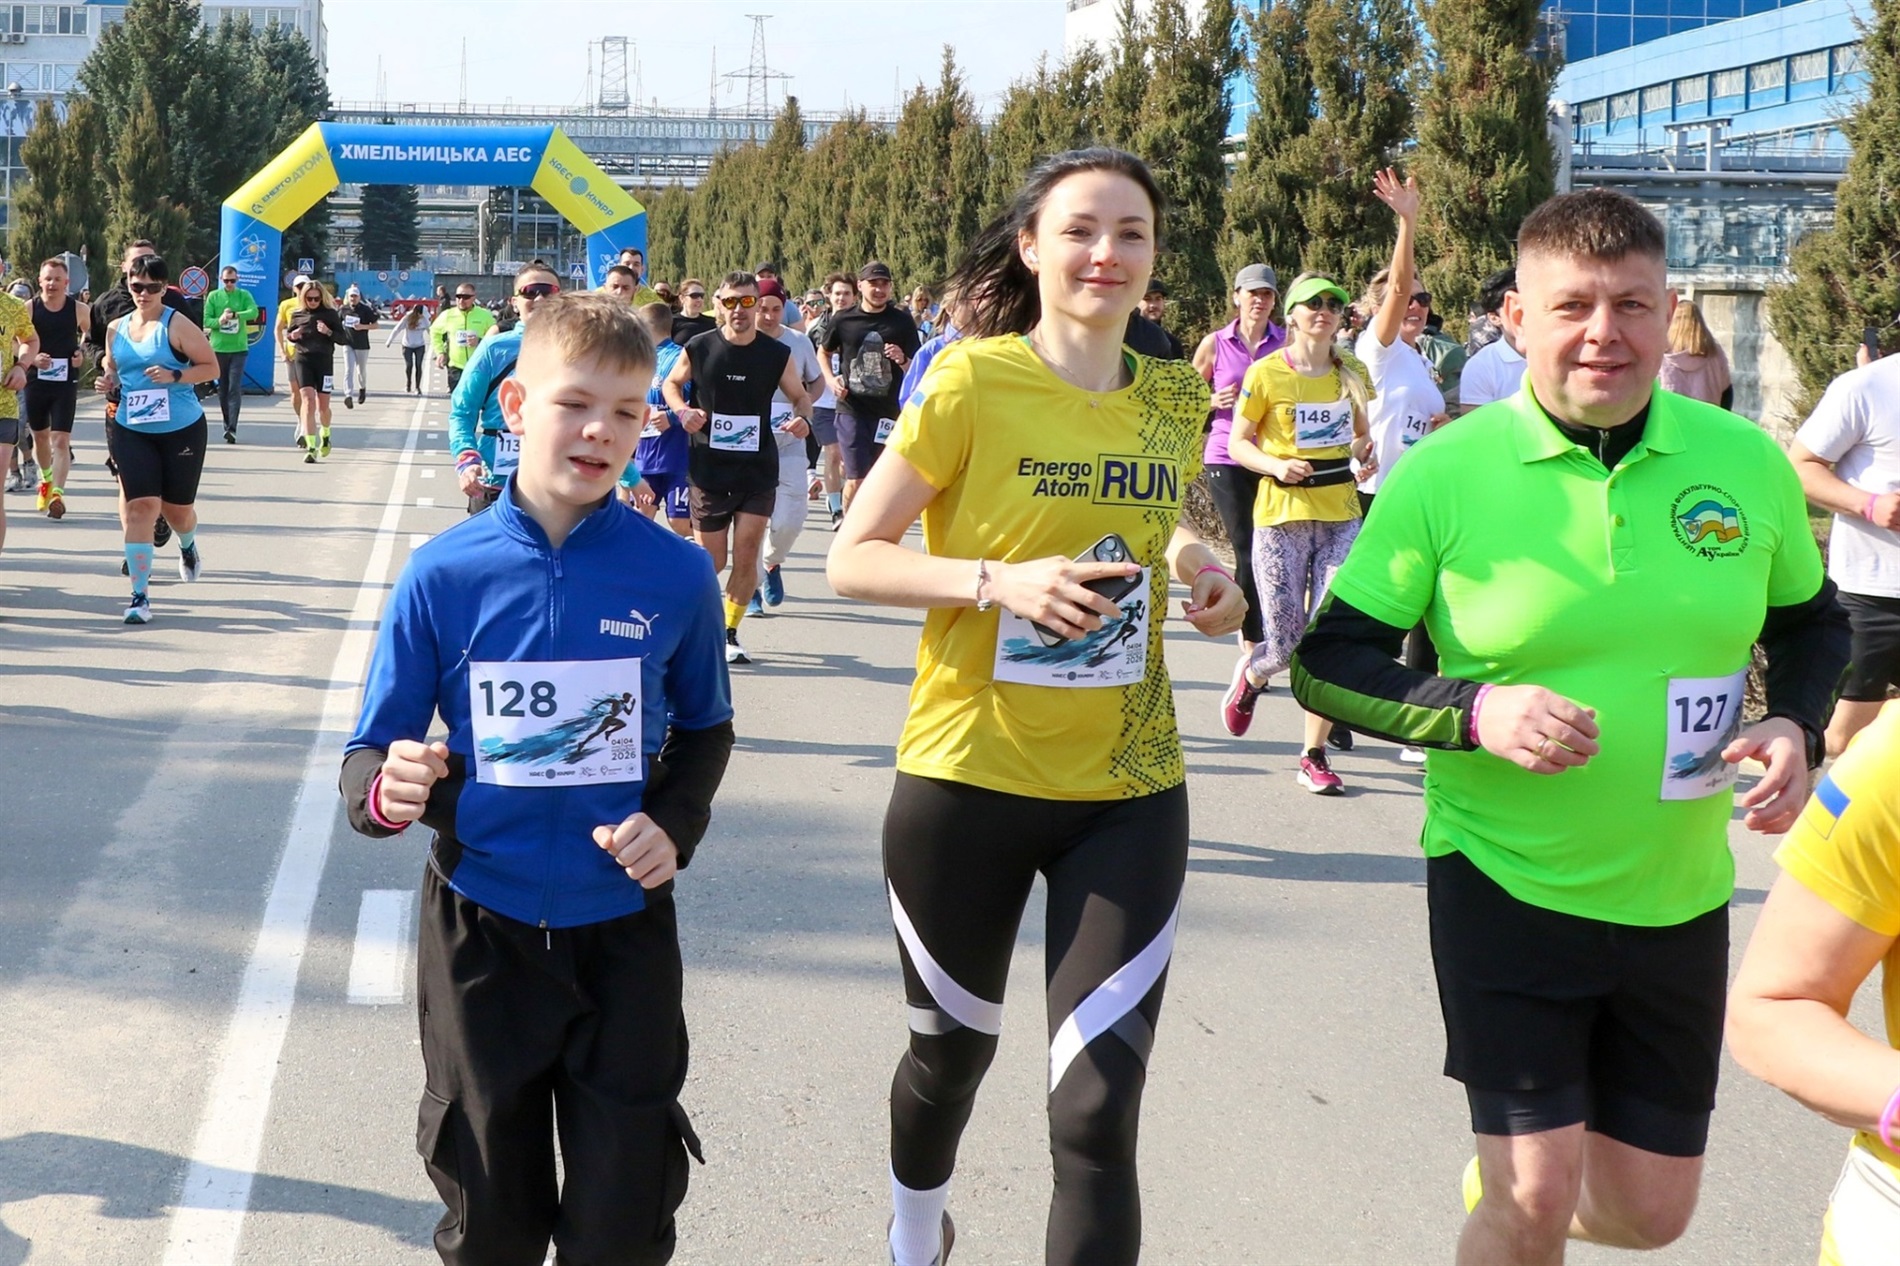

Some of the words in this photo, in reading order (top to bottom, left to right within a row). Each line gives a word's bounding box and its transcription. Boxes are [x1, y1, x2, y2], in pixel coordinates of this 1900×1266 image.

[339, 144, 488, 164] ХМЕЛЬНИЦЬКА
[493, 147, 532, 162] АЕС
[128, 395, 148, 406] 277
[714, 419, 733, 431] 60
[1299, 410, 1331, 424] 148
[1407, 415, 1427, 435] 141
[1018, 458, 1092, 481] Energo
[1032, 478, 1090, 497] Atom
[1101, 460, 1177, 502] RUN
[600, 619, 644, 640] PUMA
[478, 680, 557, 718] 128
[1675, 694, 1728, 732] 127
[611, 751, 637, 760] 2026
